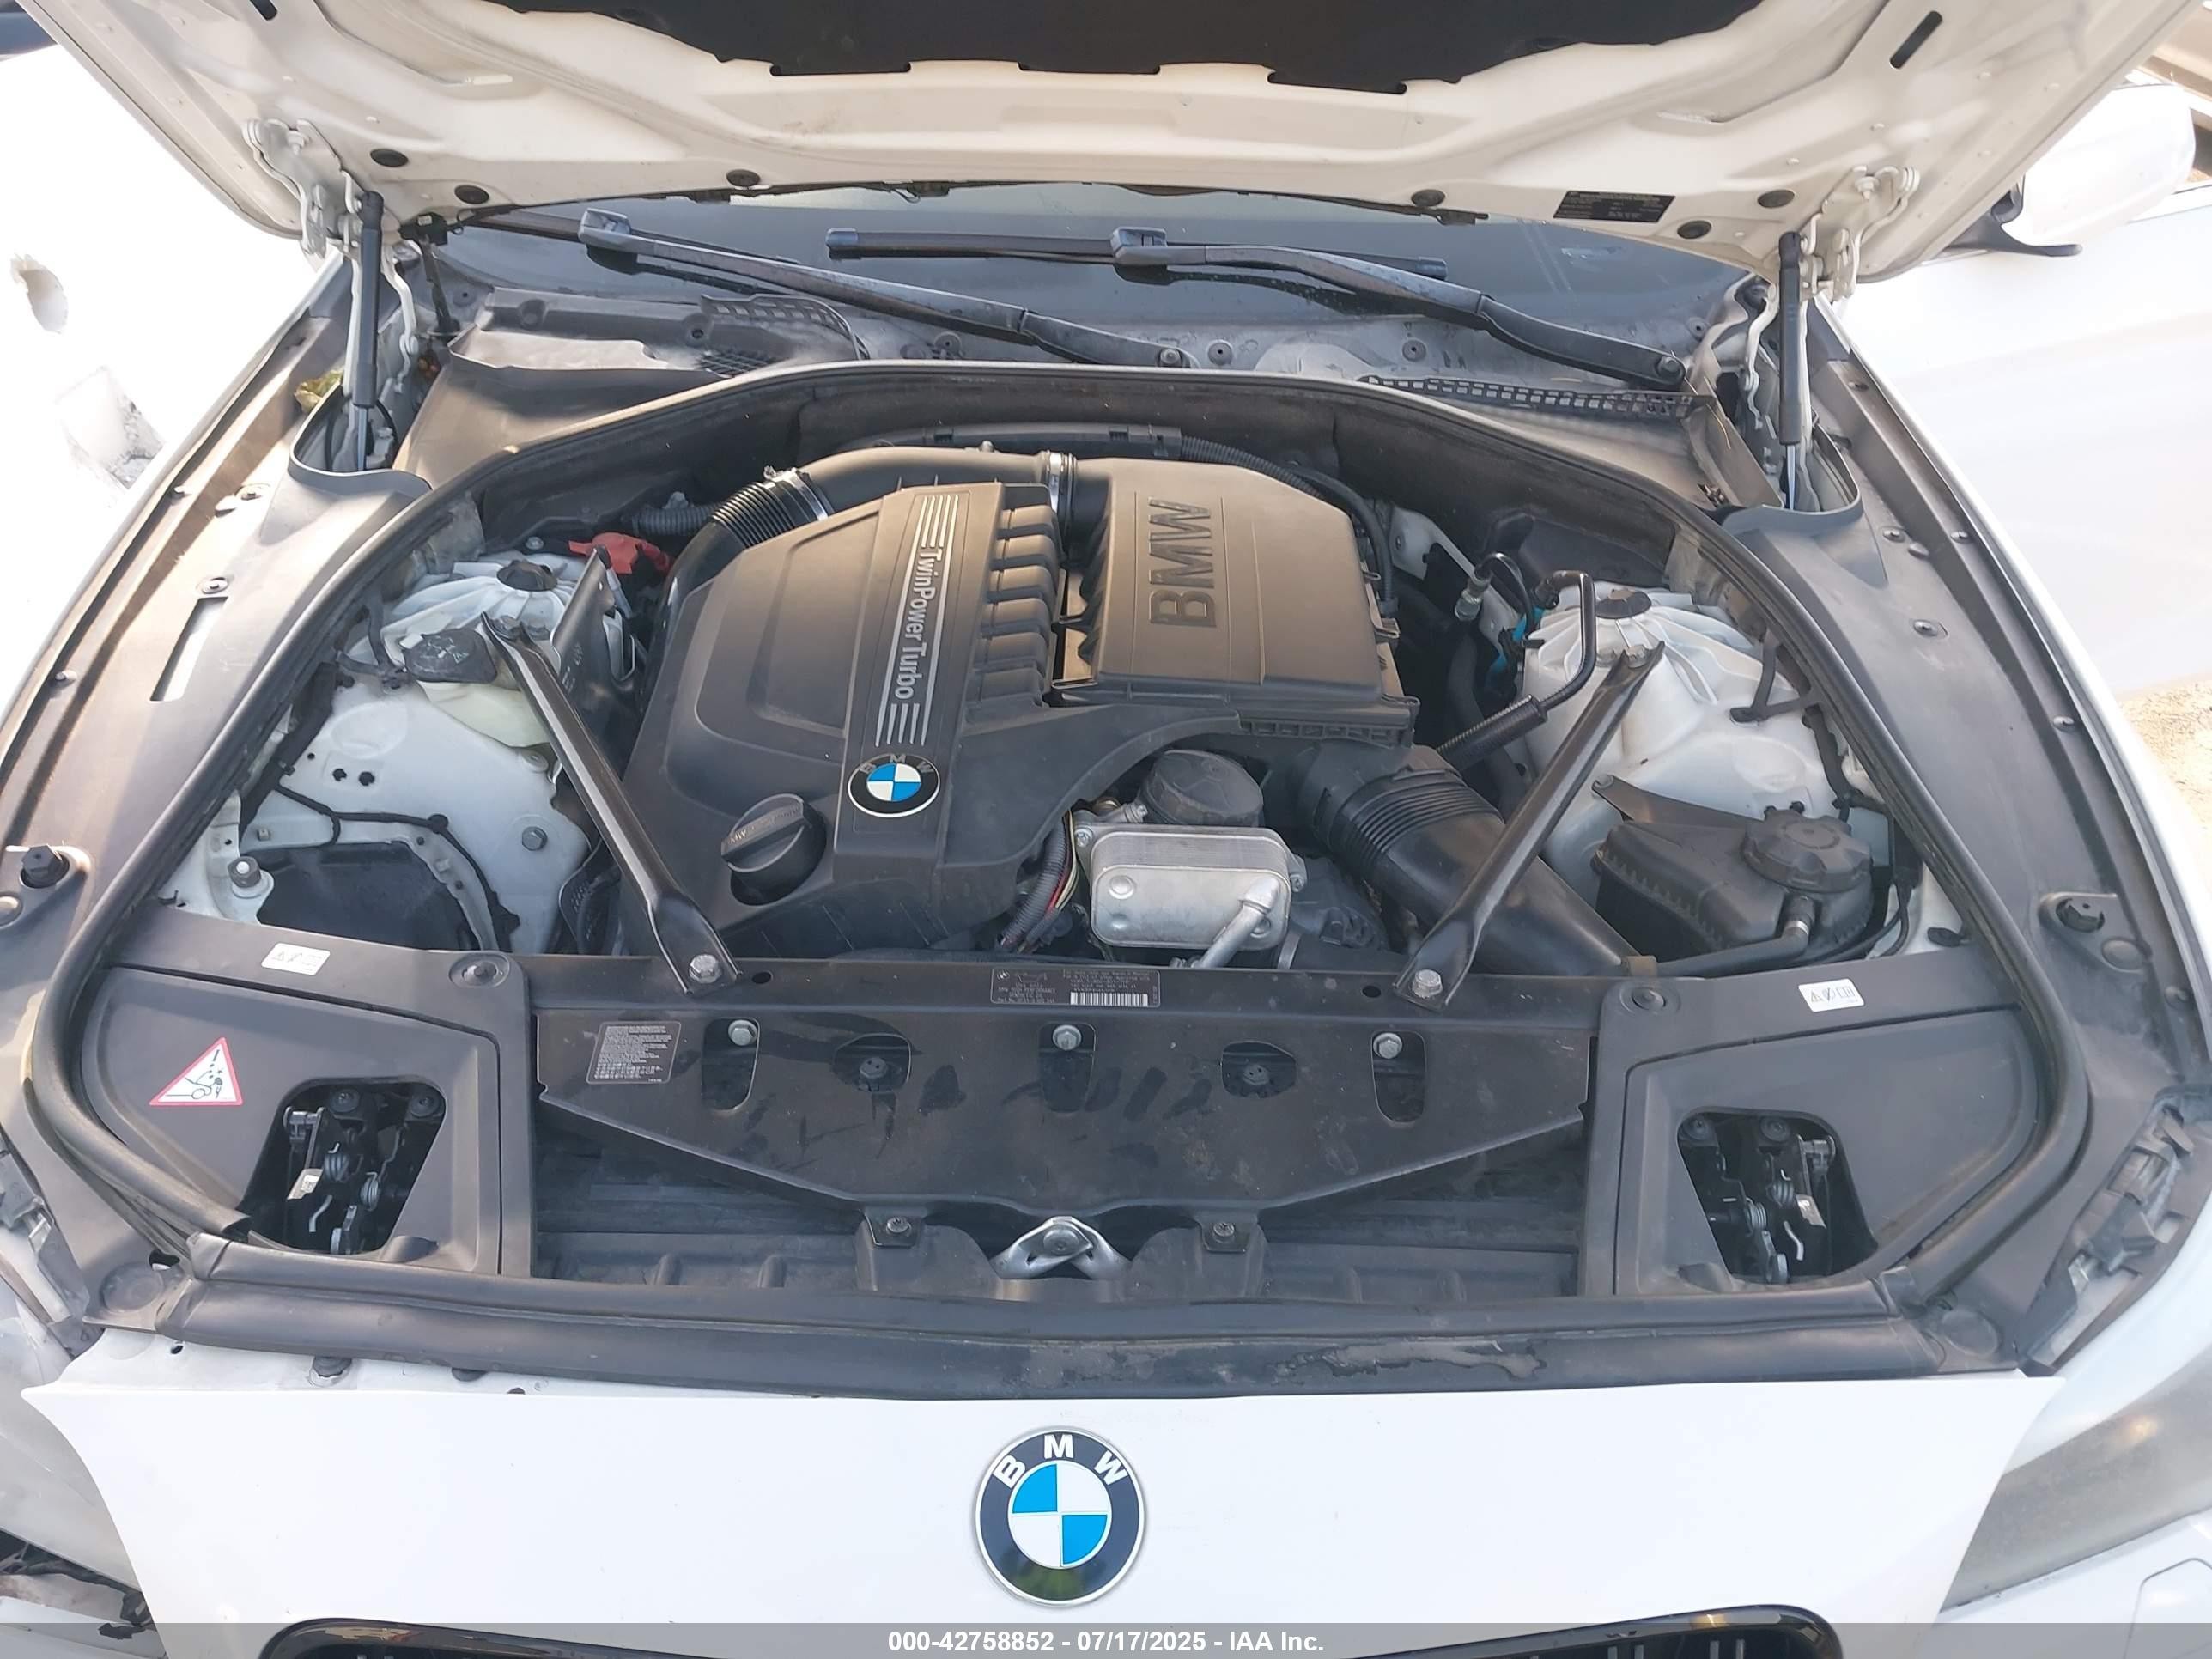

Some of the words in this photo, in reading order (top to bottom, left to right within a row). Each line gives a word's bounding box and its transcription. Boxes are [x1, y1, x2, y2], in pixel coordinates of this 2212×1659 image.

[1148, 497, 1217, 628] BMW
[903, 545, 944, 642] TwinPower
[894, 641, 927, 700] Turbo
[859, 753, 934, 775] BMW
[993, 1433, 1129, 1489] BMW
